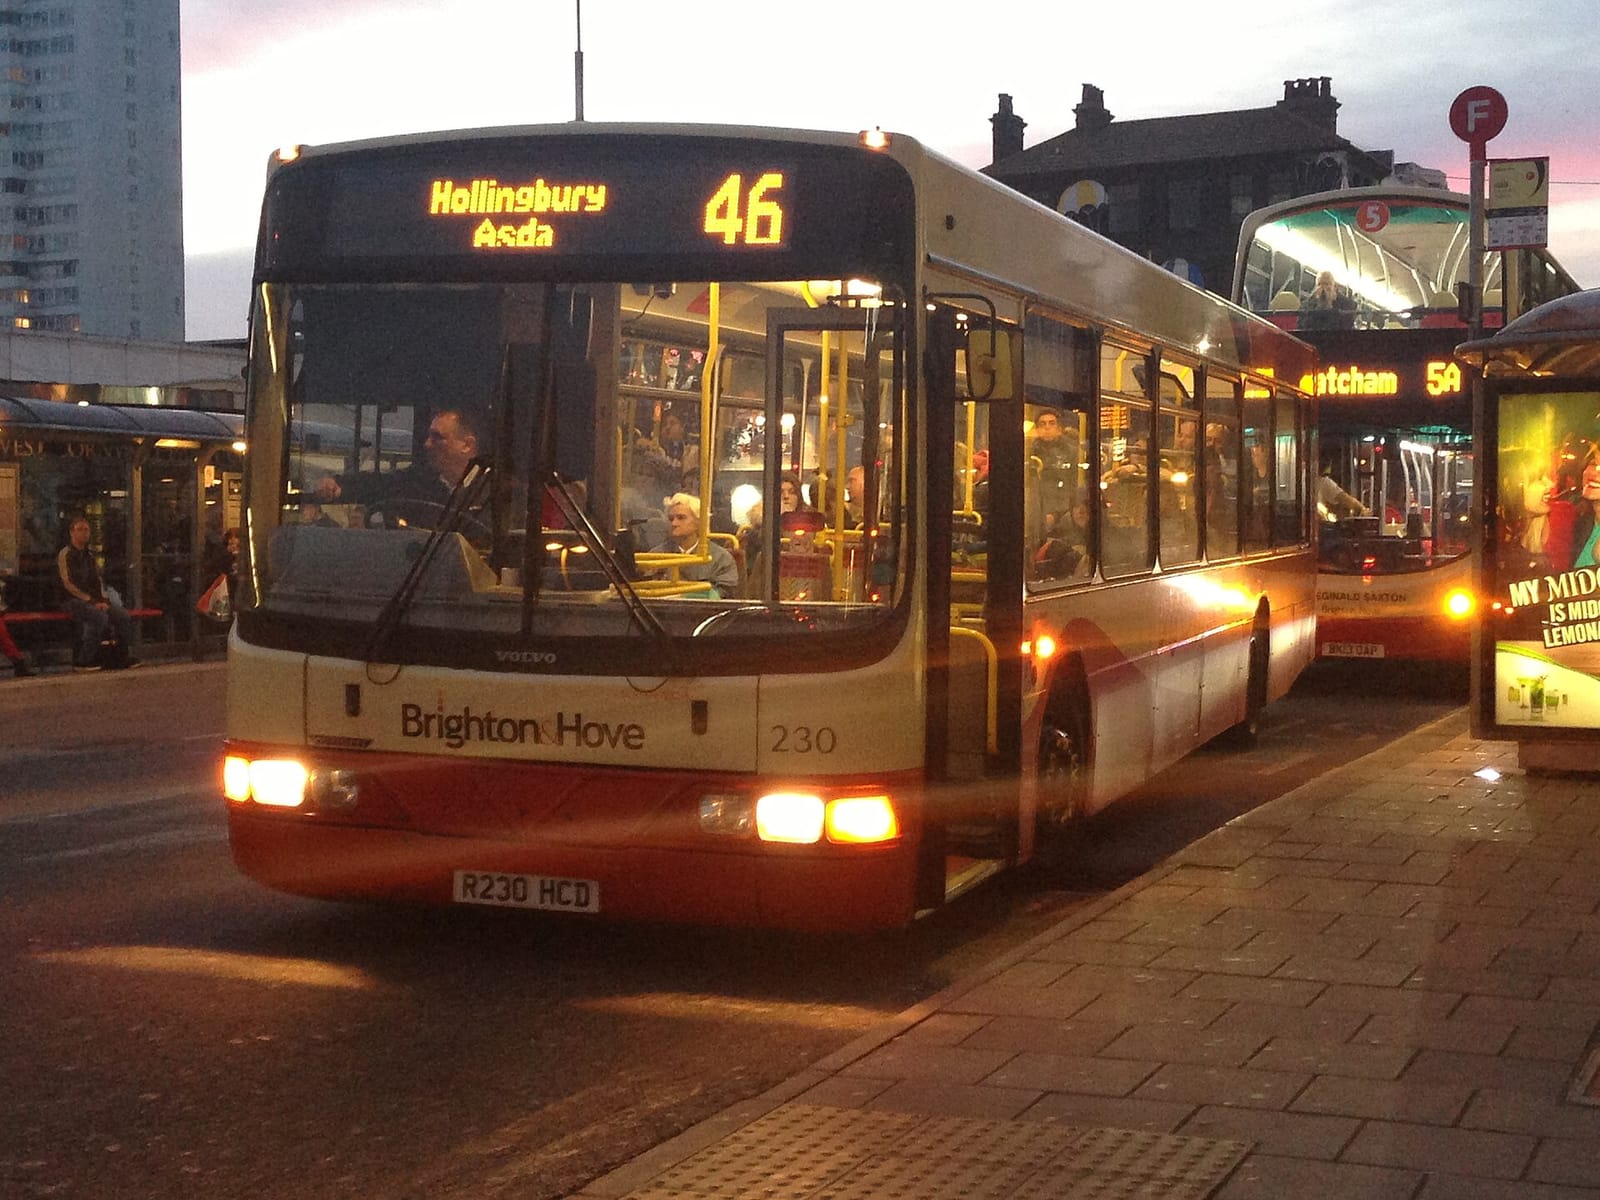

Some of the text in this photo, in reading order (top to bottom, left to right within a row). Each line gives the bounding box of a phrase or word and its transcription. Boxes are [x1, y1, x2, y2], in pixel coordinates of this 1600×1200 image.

[1466, 99, 1490, 132] F
[430, 178, 607, 215] Hollingbury
[704, 173, 784, 246] 46
[473, 217, 554, 248] Asda
[1365, 205, 1381, 229] 5
[1317, 361, 1462, 396] atcham 5A
[1315, 590, 1407, 603] EGINALD SAXTON
[1509, 568, 1600, 608] MY MID
[1549, 599, 1600, 623] IS MID
[495, 649, 557, 664] VOLVO
[401, 702, 540, 749] Brighton
[556, 711, 646, 750] Hove
[770, 724, 837, 754] 230
[461, 873, 591, 909] R230 HCD
